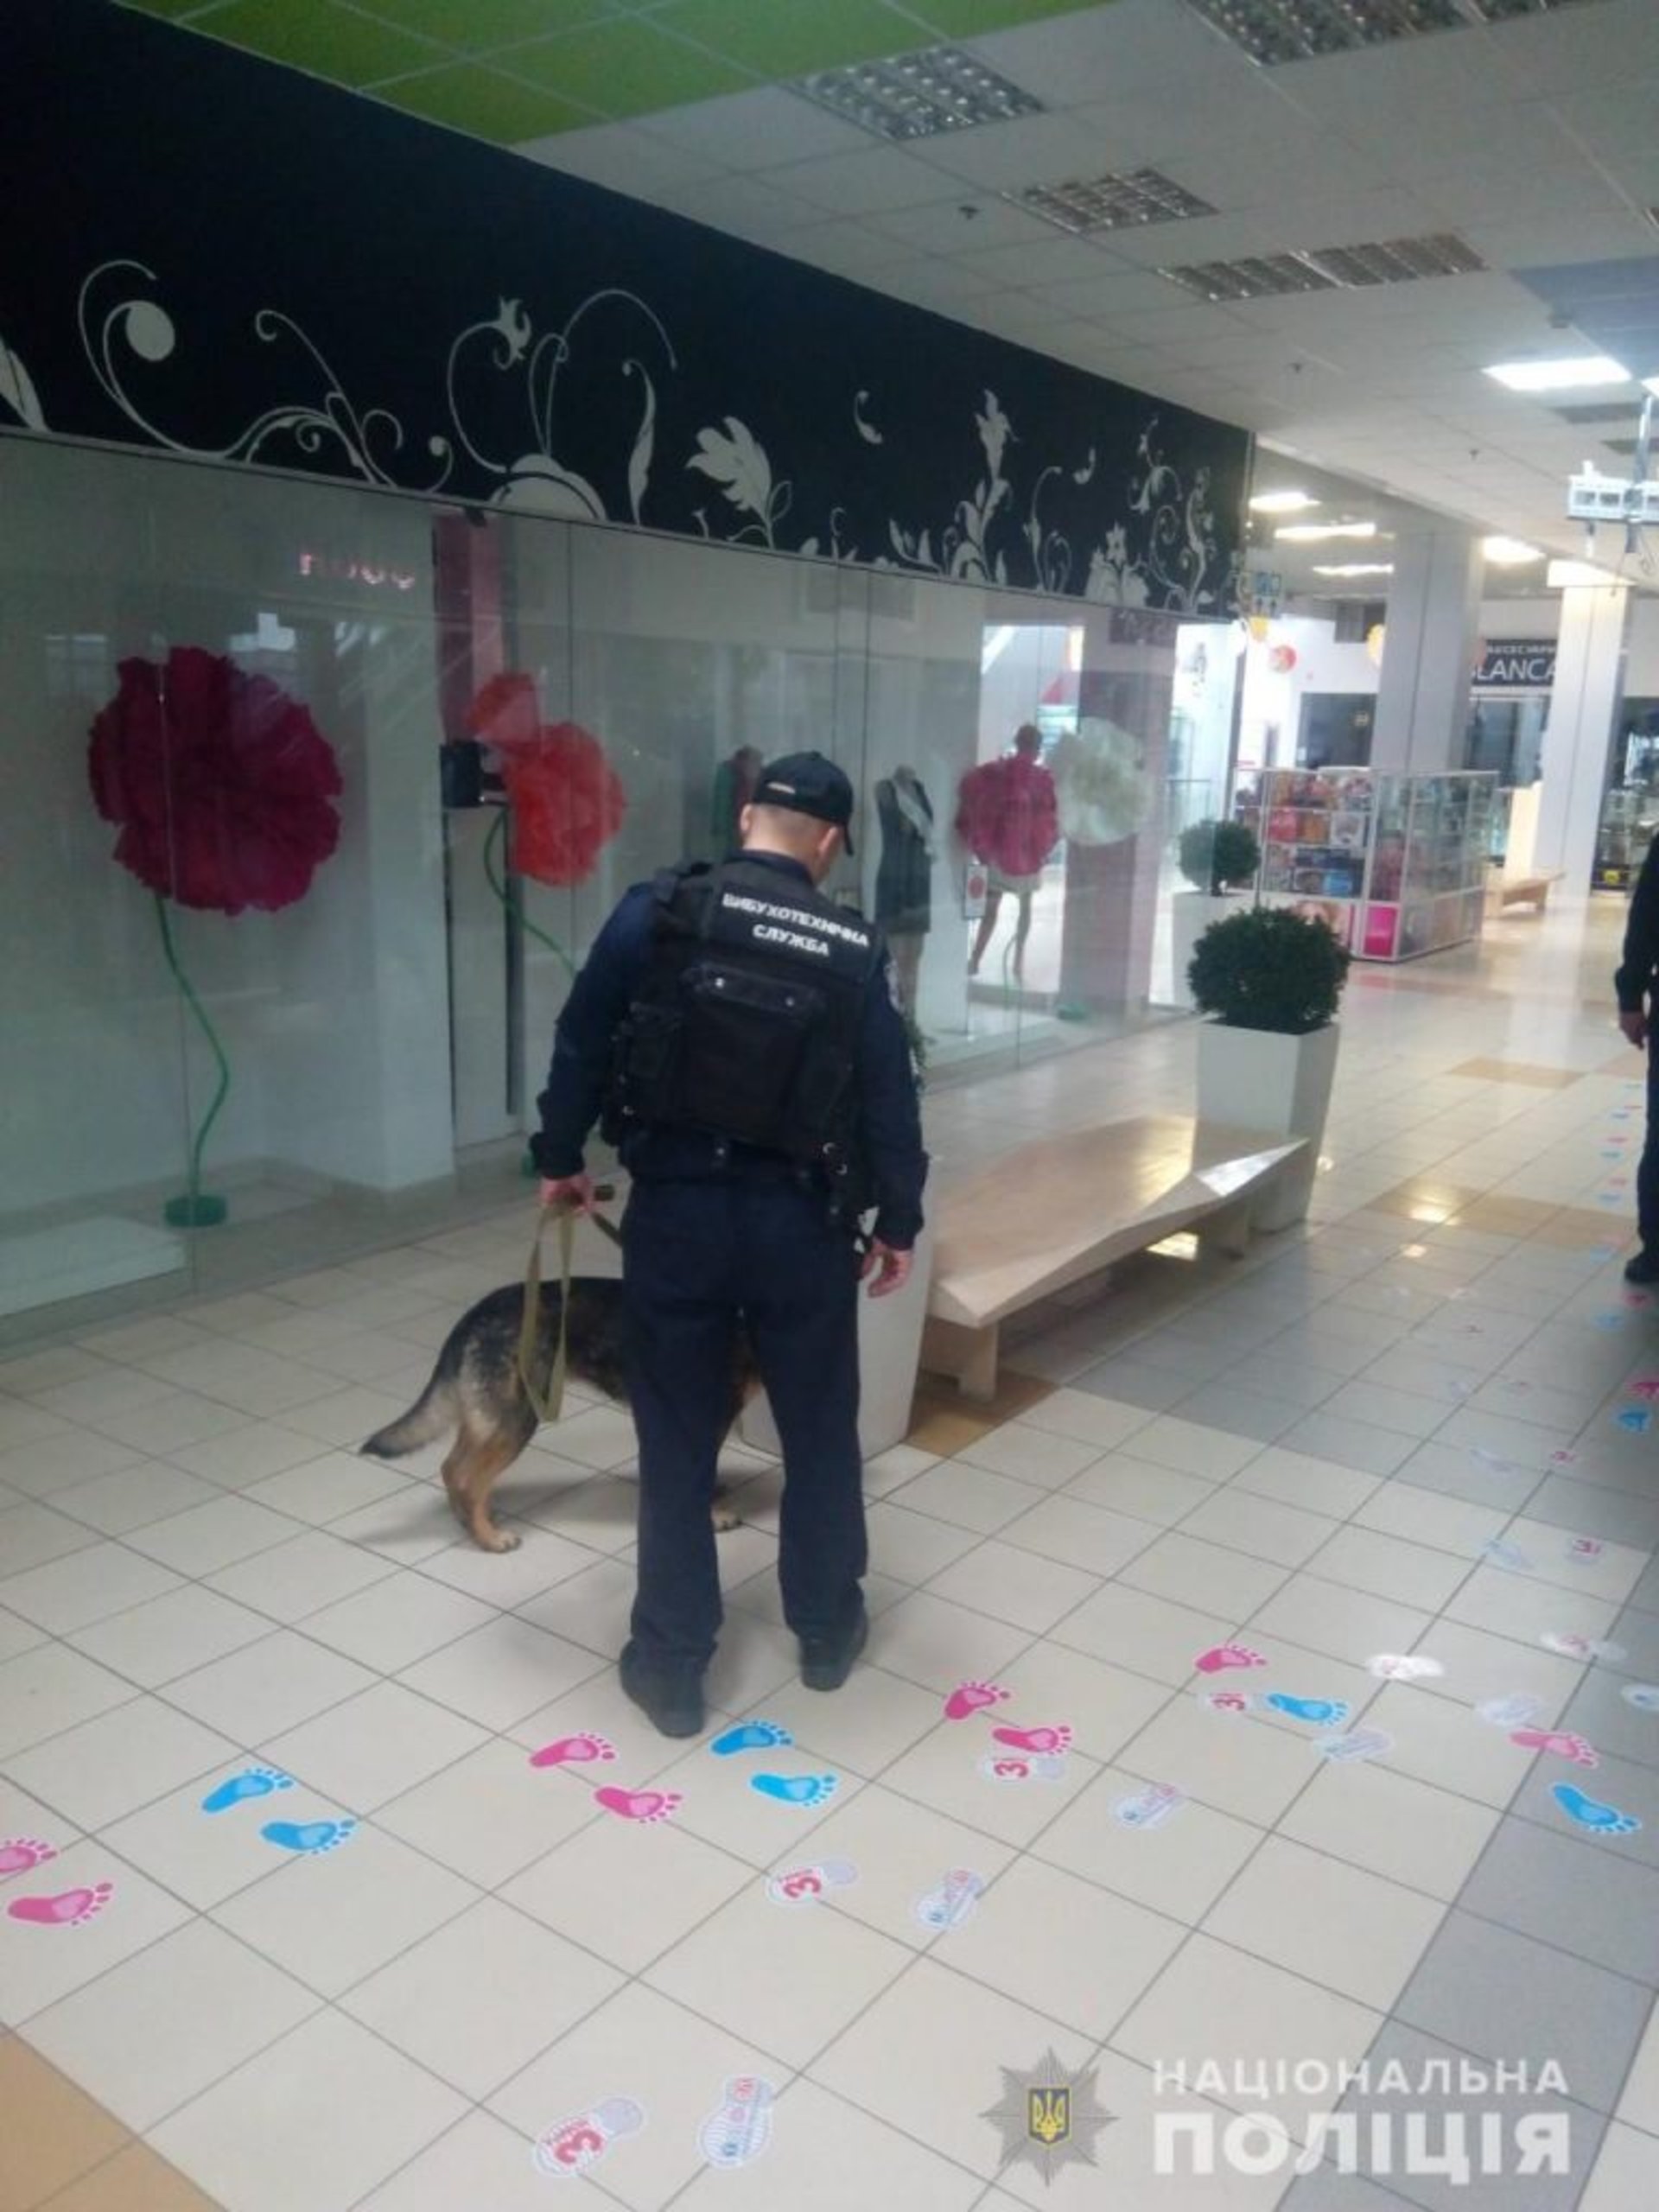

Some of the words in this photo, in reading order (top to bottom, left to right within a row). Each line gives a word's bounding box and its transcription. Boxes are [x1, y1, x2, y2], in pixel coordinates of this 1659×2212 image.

[752, 925, 830, 957] СЛУЖБА
[995, 1761, 1029, 1778] 3
[783, 1875, 821, 1898] 3
[556, 2130, 602, 2164] 3
